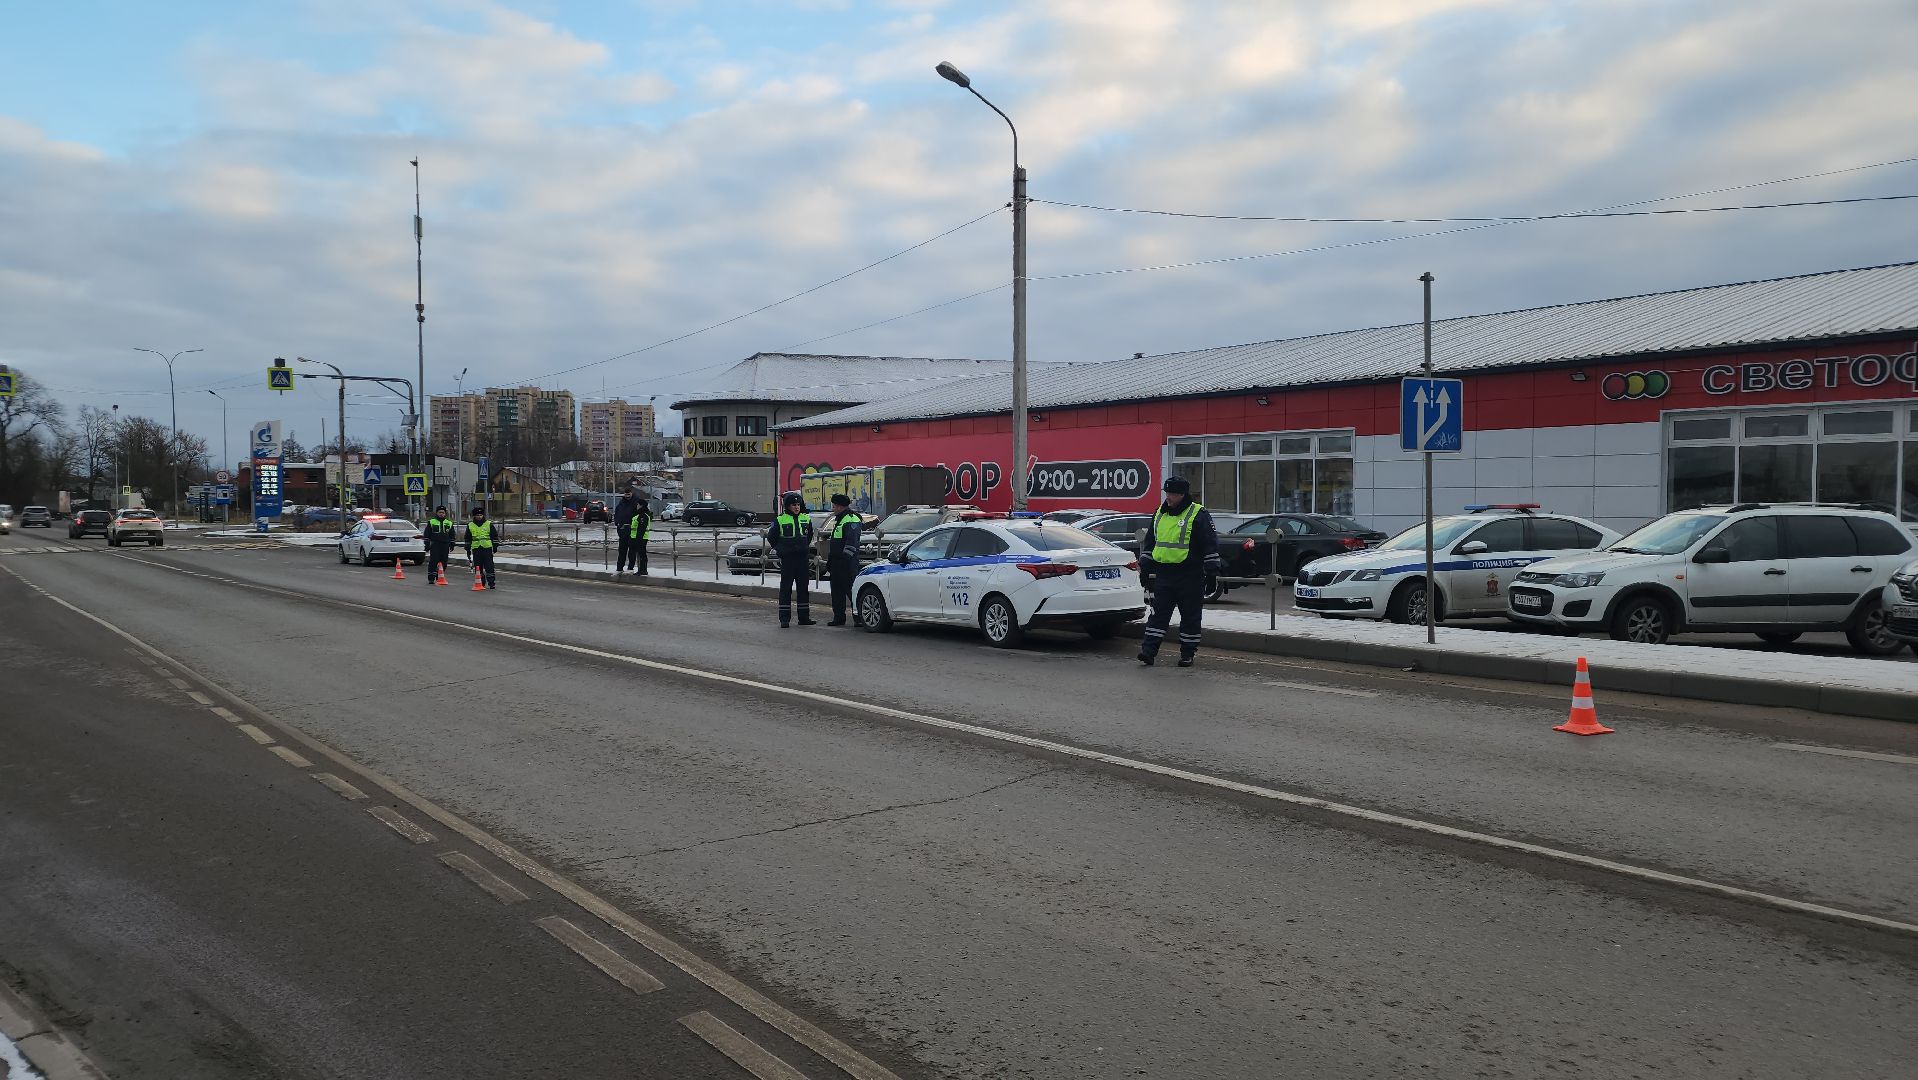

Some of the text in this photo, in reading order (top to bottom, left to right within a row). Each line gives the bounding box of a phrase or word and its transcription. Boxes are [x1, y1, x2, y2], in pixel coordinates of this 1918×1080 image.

[698, 440, 759, 455] ЧИЖИК
[1472, 559, 1514, 568] ПОЛИЦИЯ
[951, 592, 969, 606] 112
